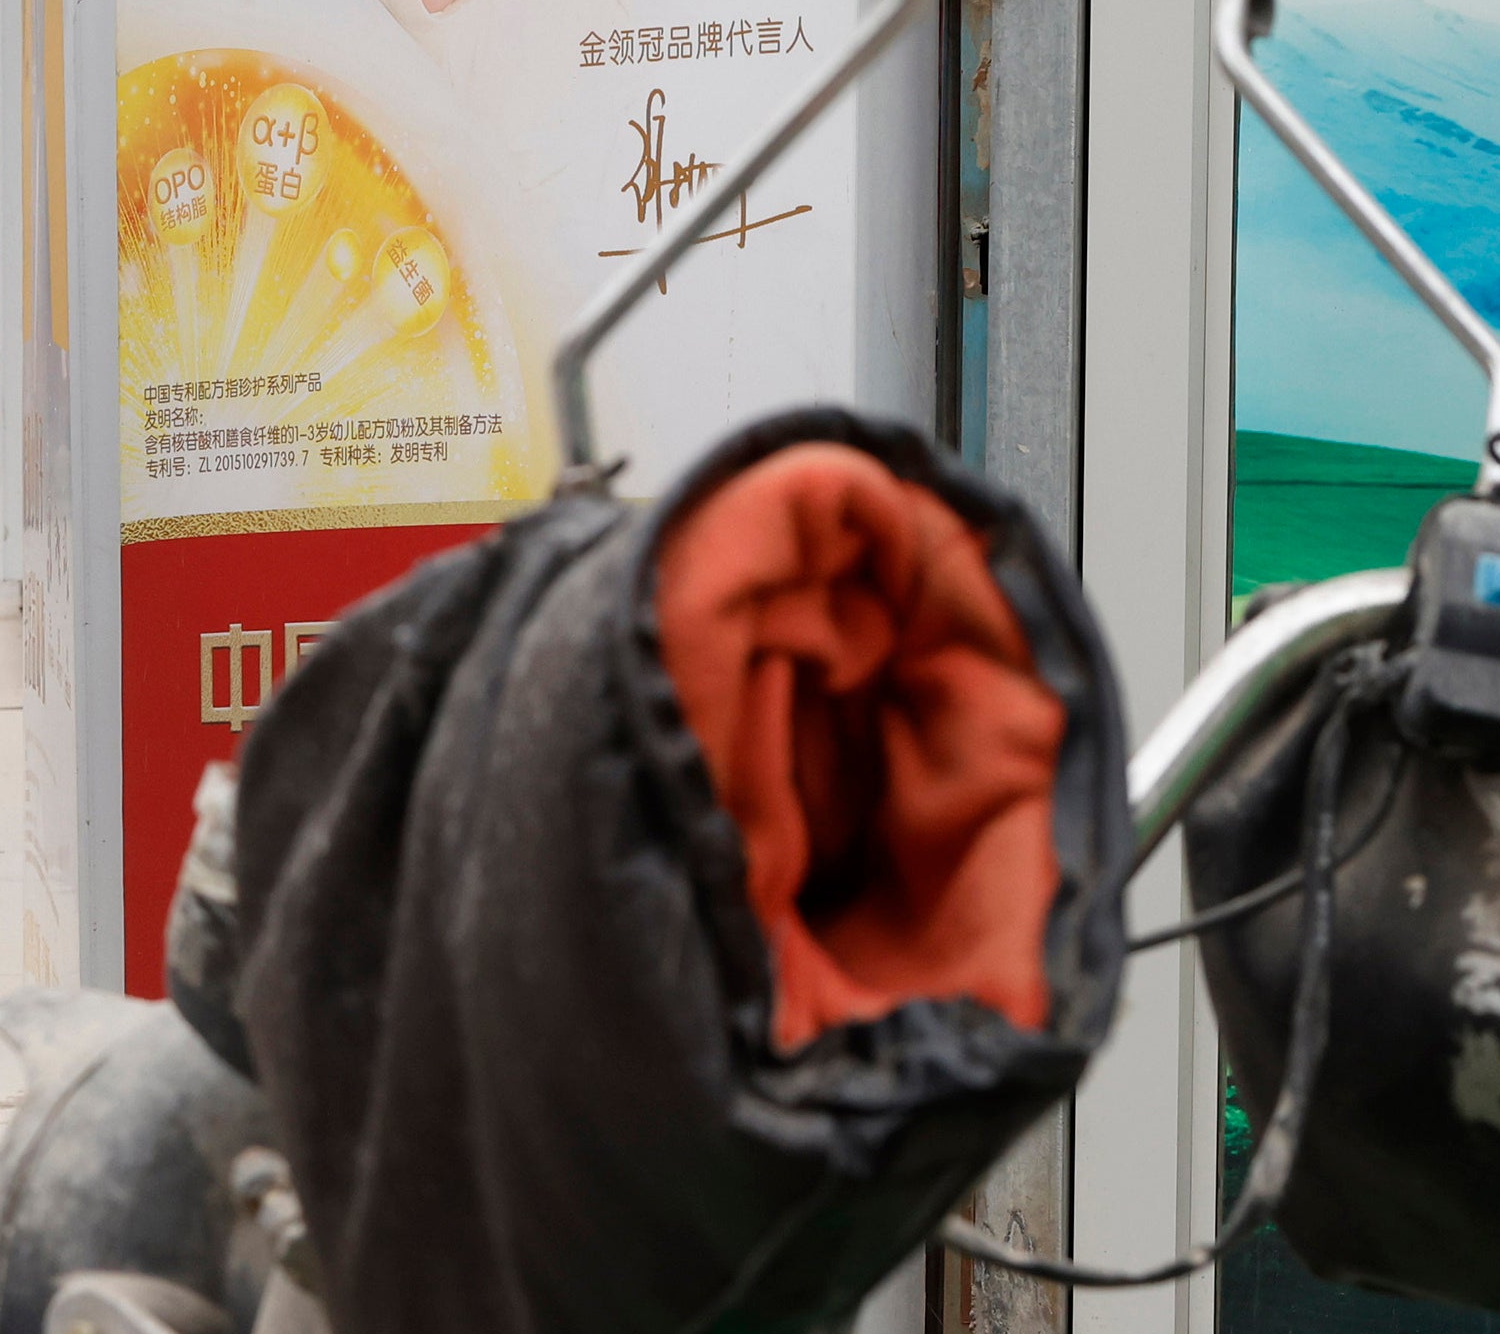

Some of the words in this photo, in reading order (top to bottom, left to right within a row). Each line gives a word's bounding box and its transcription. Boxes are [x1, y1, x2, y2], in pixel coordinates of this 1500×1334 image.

[579, 16, 814, 68] 金领冠品牌代言人
[154, 163, 206, 205] OPO
[254, 160, 302, 201] 蛋白
[159, 195, 208, 232] 结构脂
[386, 238, 435, 307] 益生菌
[143, 371, 323, 406] 中国专利配方指珍护系列产品
[198, 457, 212, 474] ZL
[390, 440, 448, 465] 发明专利
